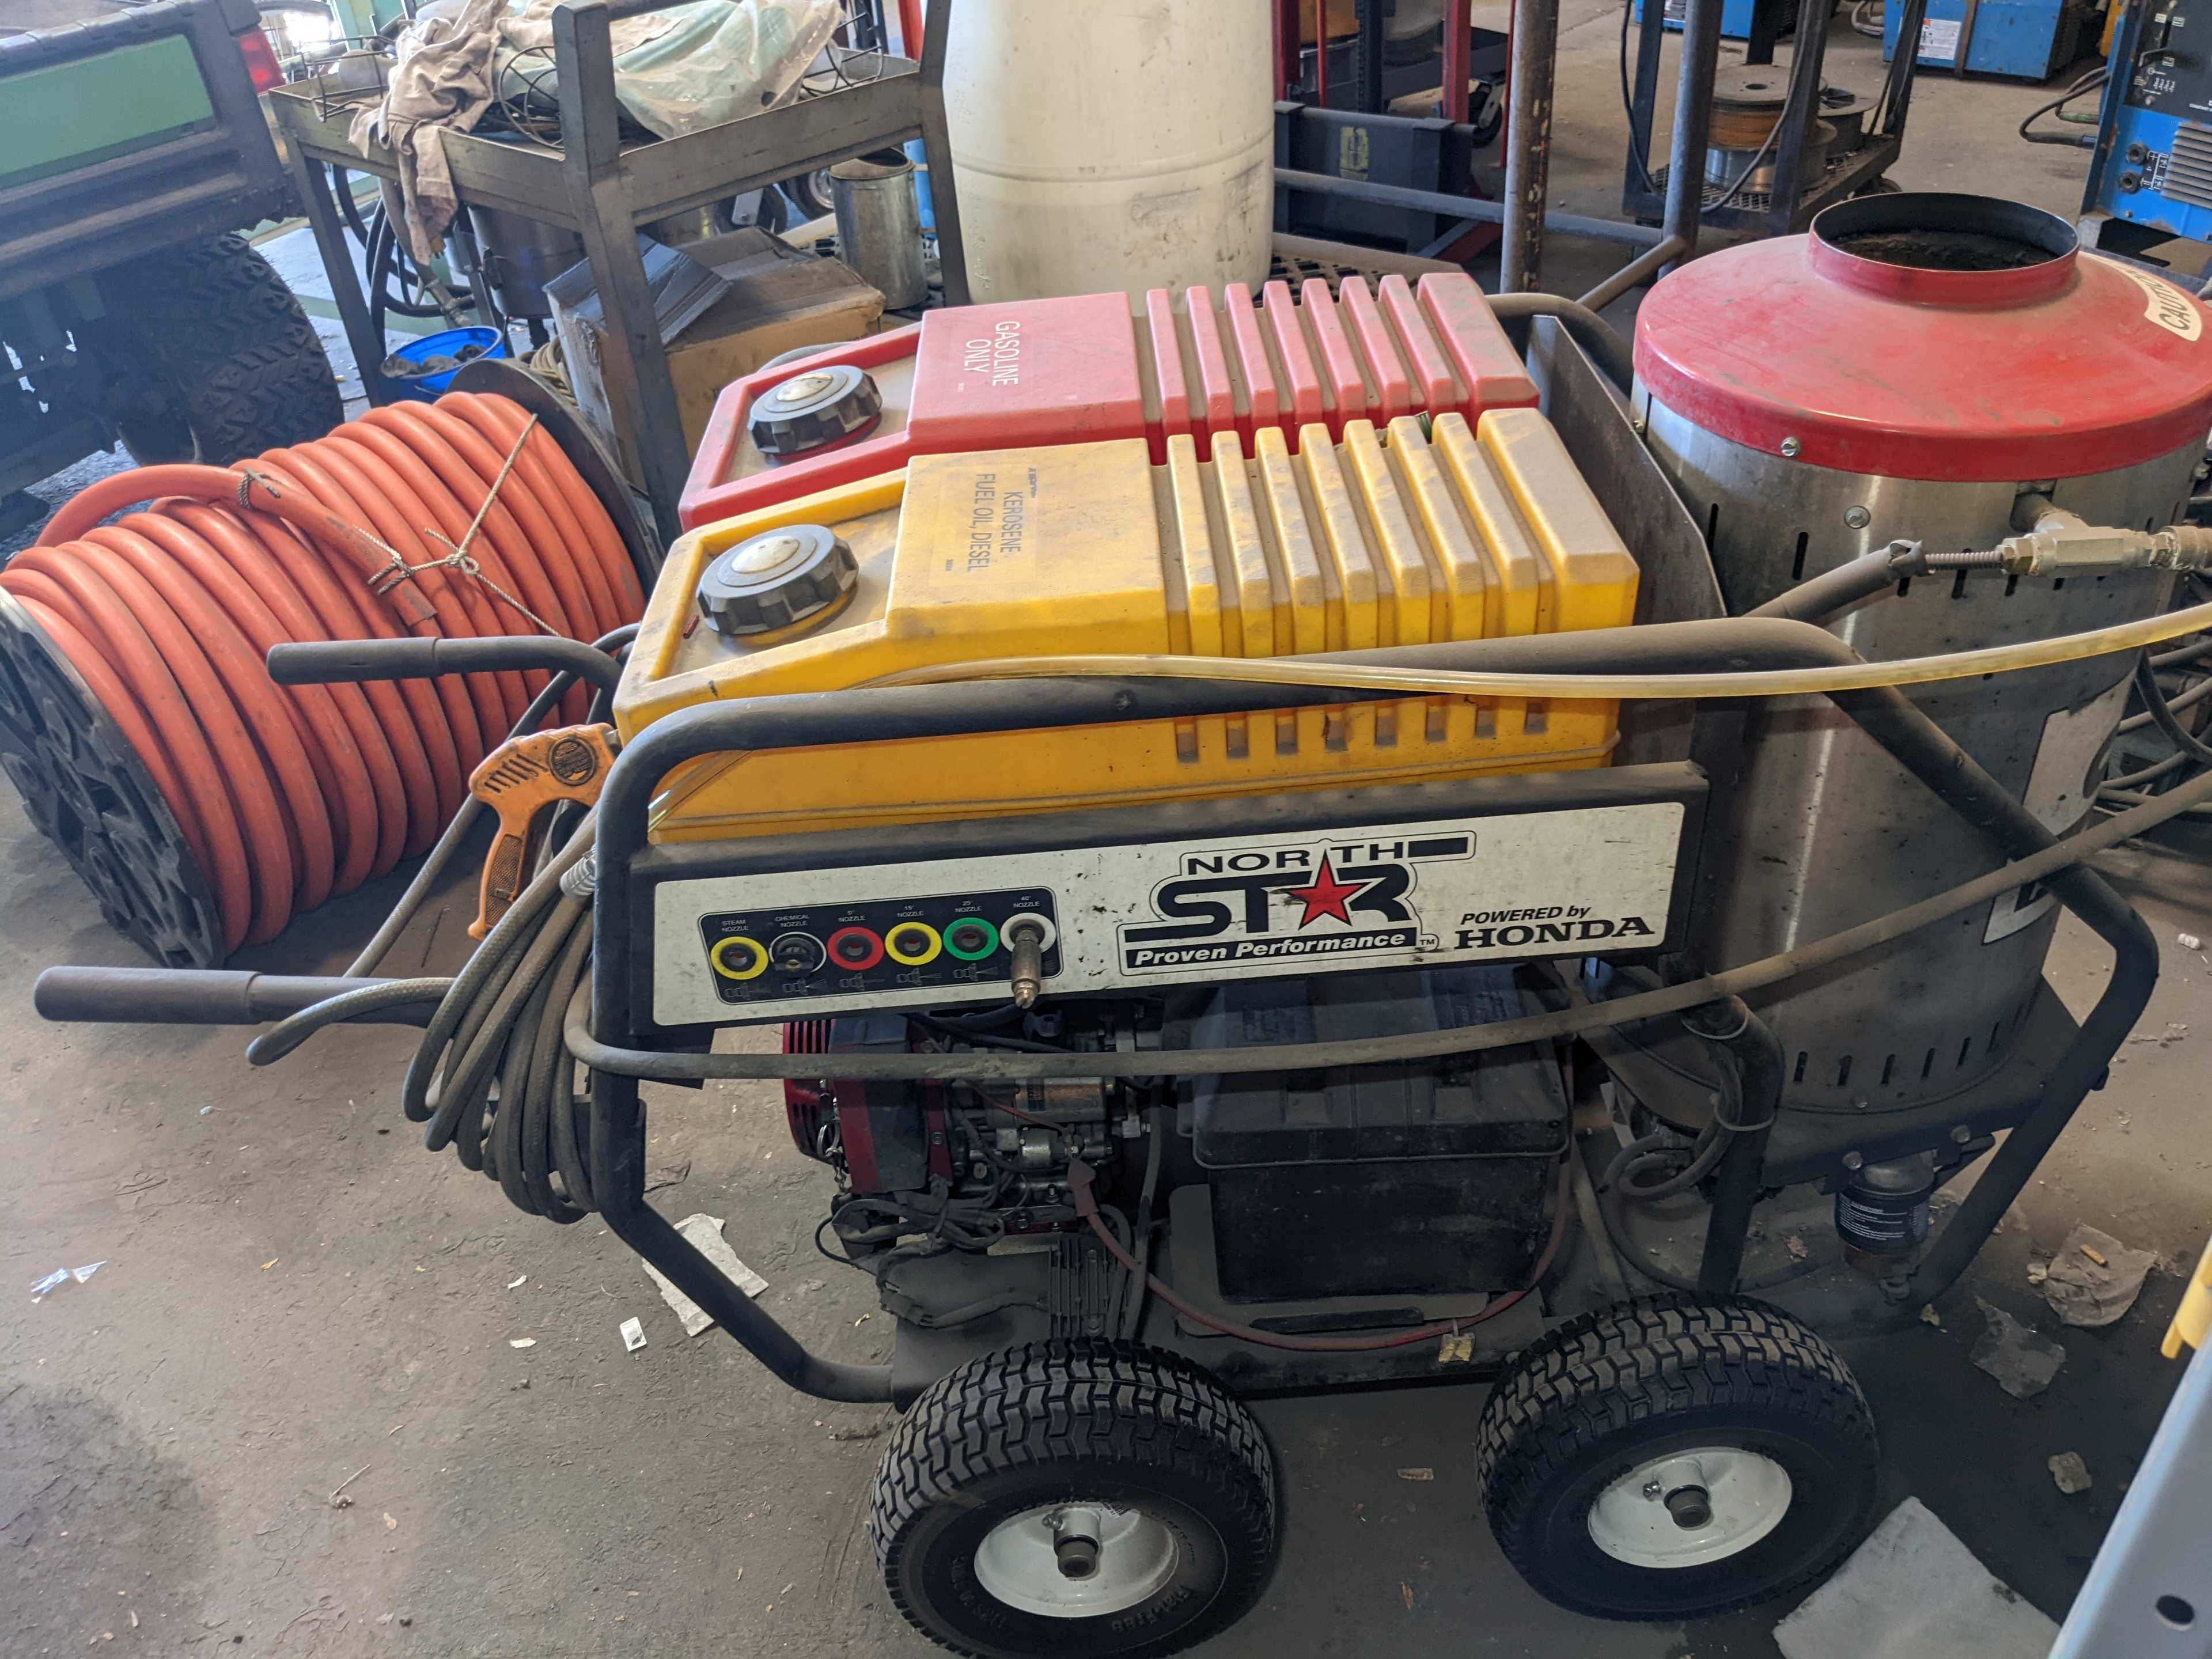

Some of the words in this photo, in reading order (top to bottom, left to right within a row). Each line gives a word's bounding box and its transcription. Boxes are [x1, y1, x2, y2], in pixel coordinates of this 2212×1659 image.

[963, 339, 991, 373] ONLY
[992, 320, 1021, 387] GASOLINE
[974, 474, 996, 505] FUEL
[969, 507, 994, 529] OIL,
[999, 491, 1024, 553] KEROSENE
[967, 533, 993, 572] DIESEL
[1187, 841, 1404, 876] NORTH
[774, 914, 810, 922] CHEMICAL
[896, 910, 925, 918] NOZZLE
[1013, 900, 1040, 908] NOZZLE
[1460, 907, 1564, 925] POWERED
[1566, 906, 1592, 920] by
[1419, 937, 1435, 946] TM
[1453, 916, 1655, 950] HONDA
[1134, 946, 1227, 966] Proven
[1234, 934, 1406, 958] Performance
